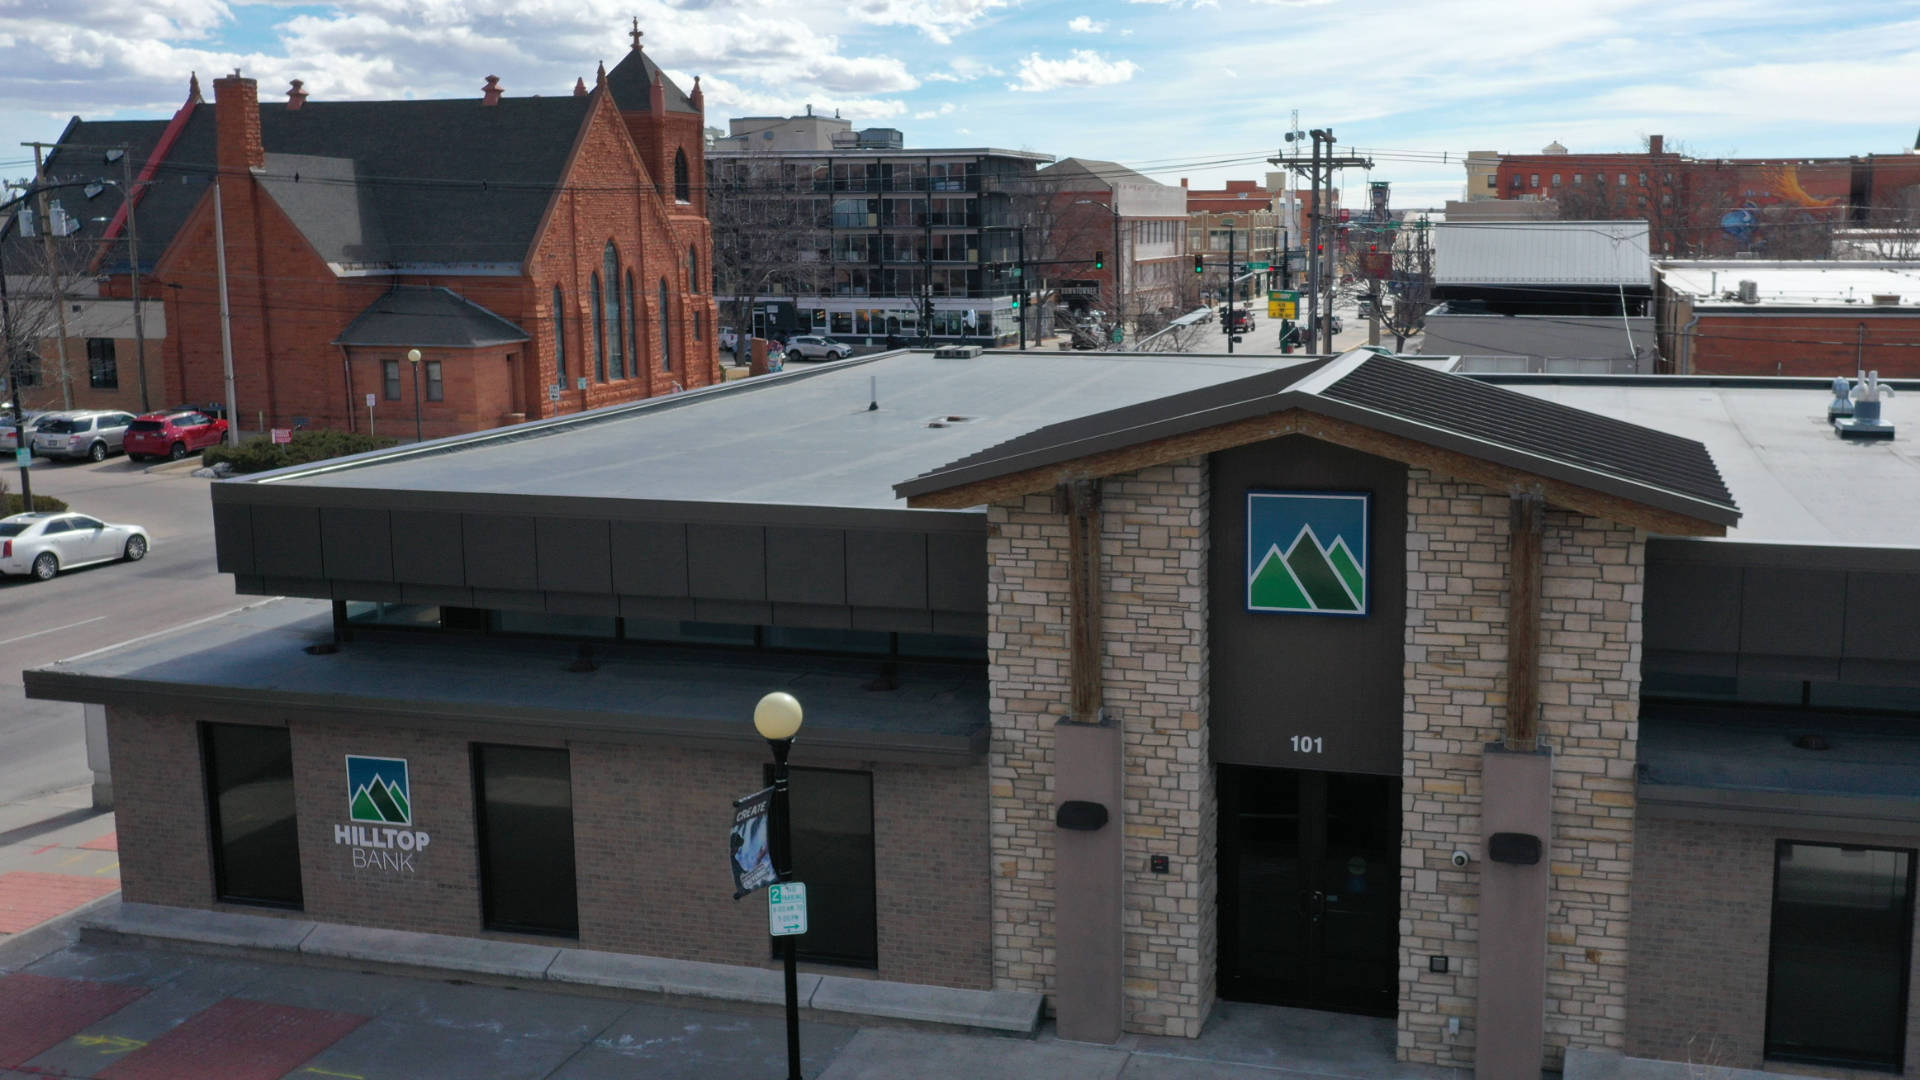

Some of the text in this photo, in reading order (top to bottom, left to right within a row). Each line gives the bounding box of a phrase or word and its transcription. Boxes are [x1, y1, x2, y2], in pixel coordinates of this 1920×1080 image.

[1290, 735, 1323, 754] 101
[736, 800, 768, 822] CREATE
[334, 824, 431, 852] HILLTOP
[352, 848, 415, 873] BANK
[771, 888, 780, 902] 2
